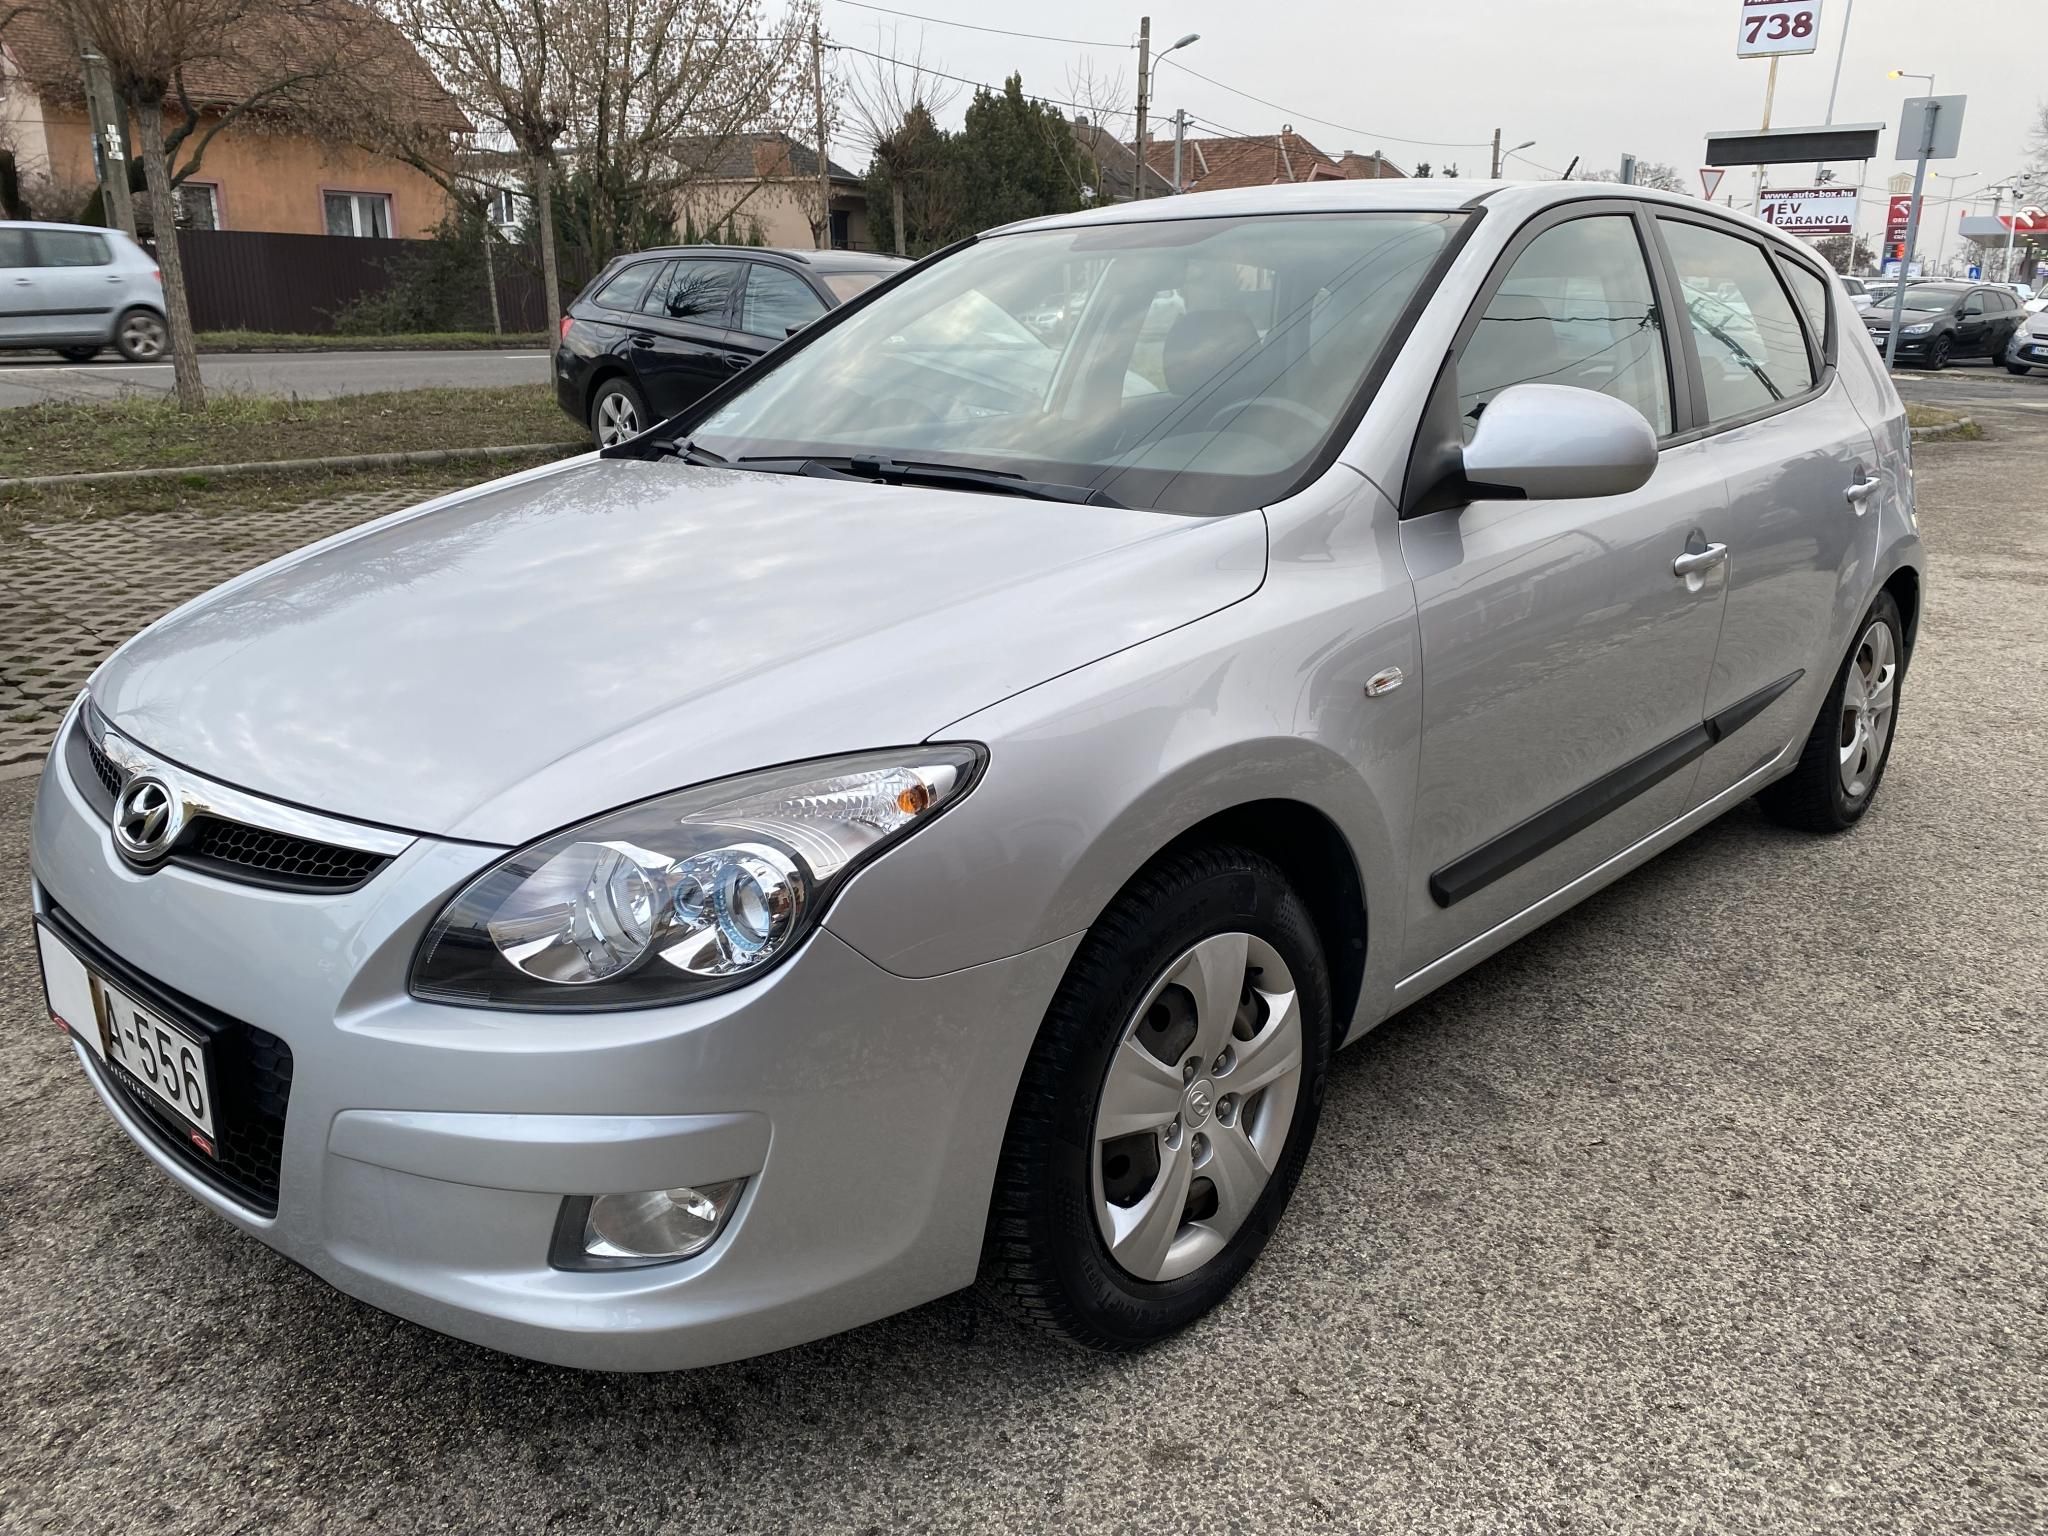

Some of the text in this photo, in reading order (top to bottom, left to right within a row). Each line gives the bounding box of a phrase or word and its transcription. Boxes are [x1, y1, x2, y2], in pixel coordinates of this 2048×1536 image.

[1745, 11, 1813, 44] 738
[1764, 190, 1854, 199] www.auto-box.hu
[1761, 200, 1802, 225] 1 ÉV
[1774, 215, 1849, 225] GARANCIA
[104, 988, 204, 1119] A-556
